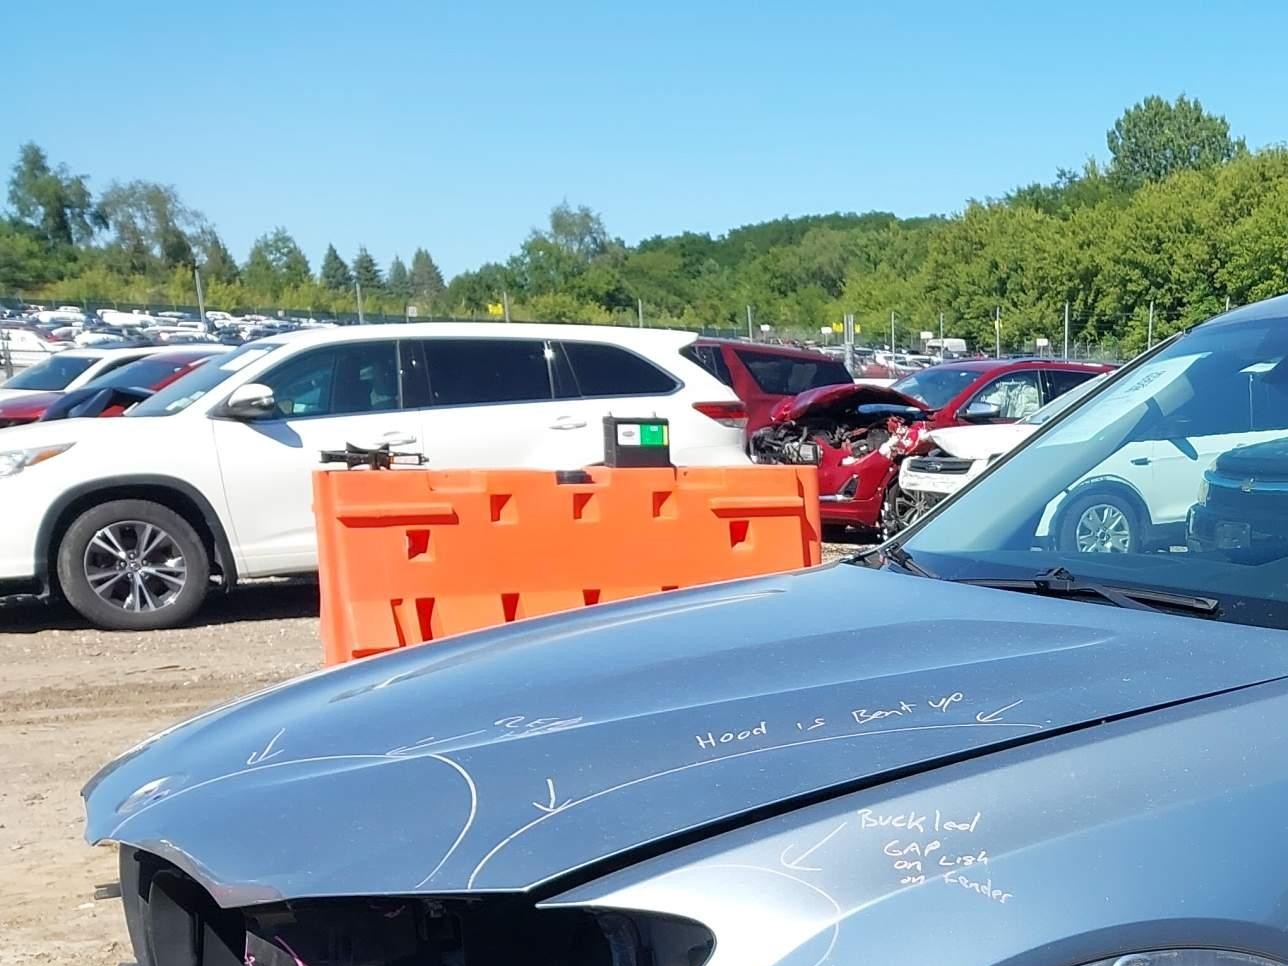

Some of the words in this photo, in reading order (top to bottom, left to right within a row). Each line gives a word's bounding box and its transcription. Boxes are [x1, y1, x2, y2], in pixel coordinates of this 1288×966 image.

[696, 722, 768, 749] Hood
[860, 809, 982, 833] Buckled
[883, 839, 943, 858] GAP
